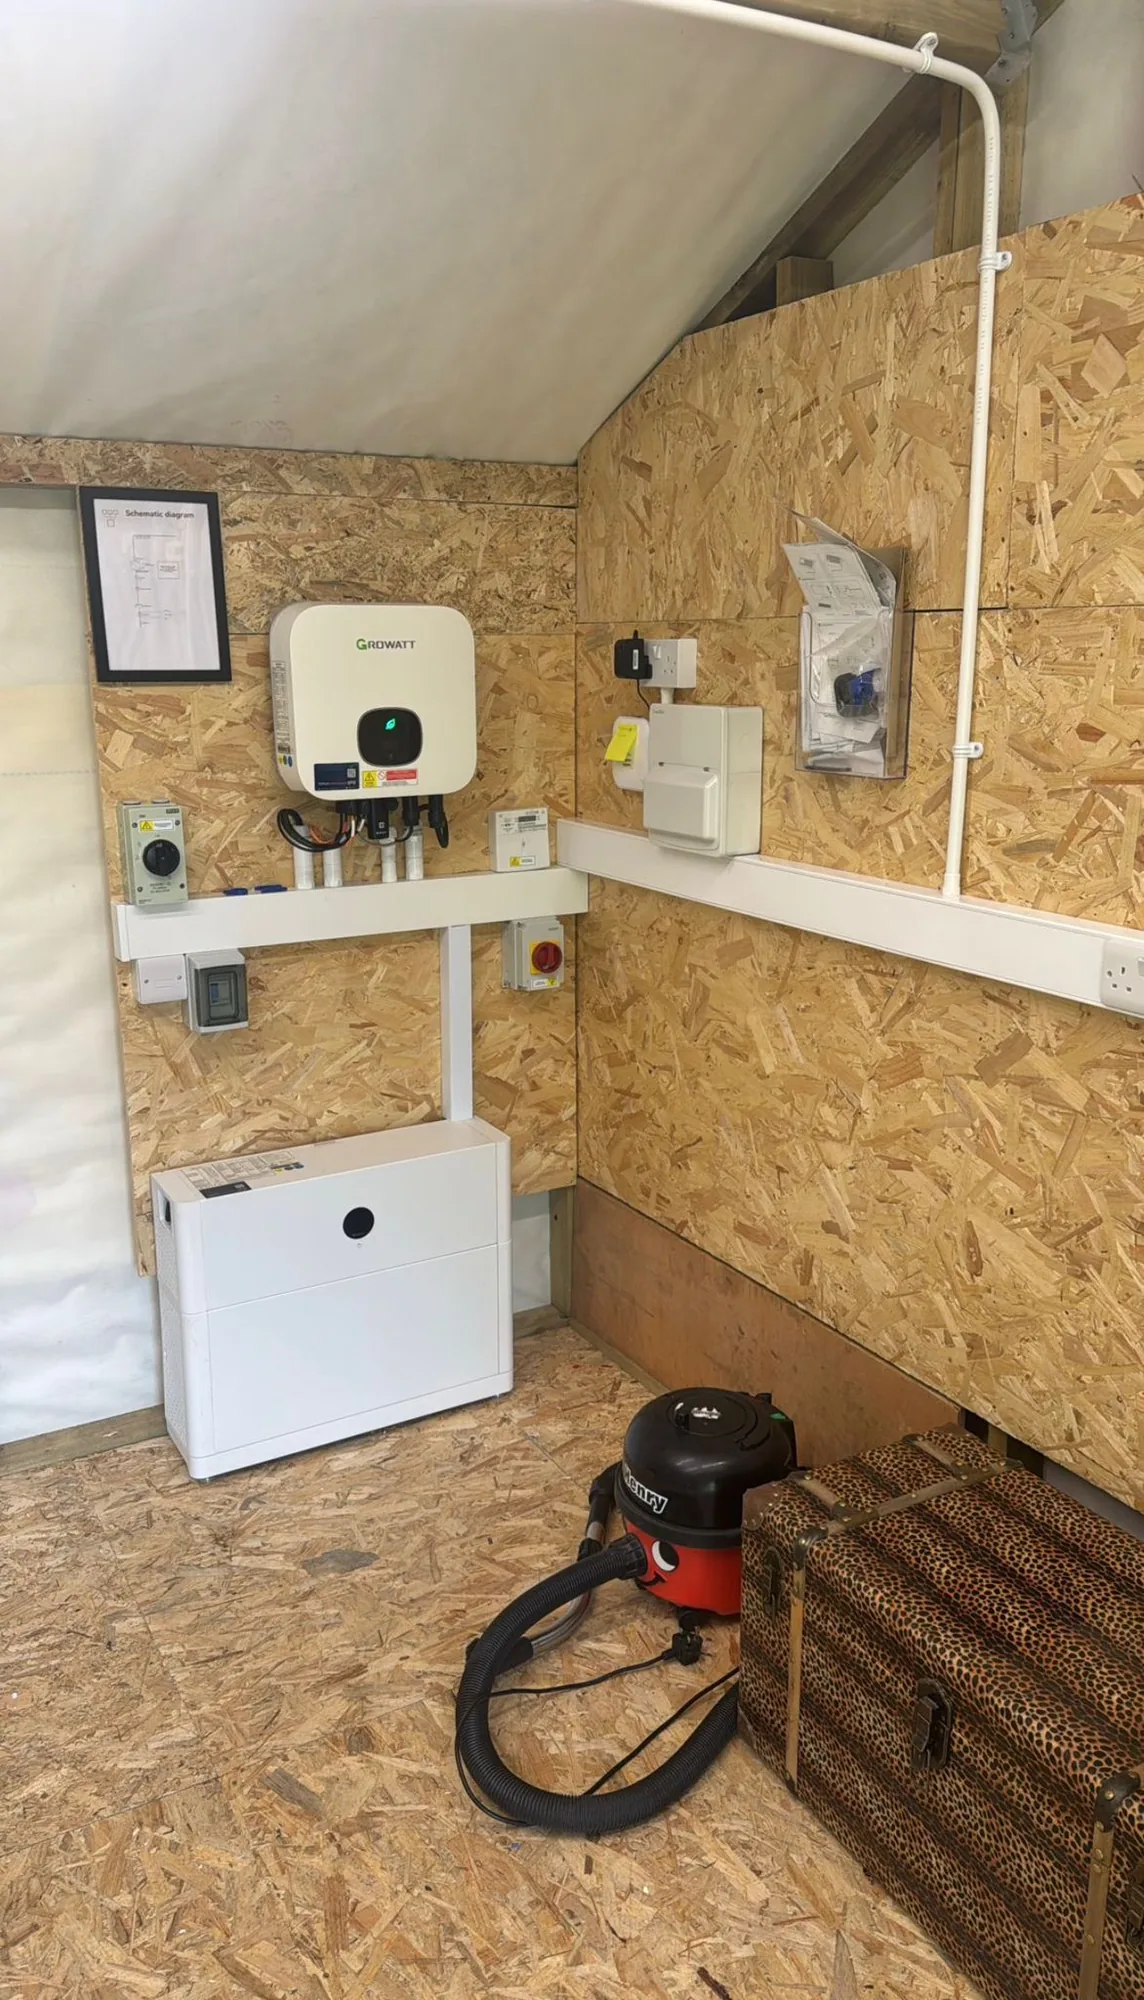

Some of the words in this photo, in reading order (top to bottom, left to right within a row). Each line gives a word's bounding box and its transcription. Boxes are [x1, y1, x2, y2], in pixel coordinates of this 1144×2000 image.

[125, 509, 163, 518] Schematic
[164, 511, 195, 520] diagram
[356, 638, 416, 650] GROWATT
